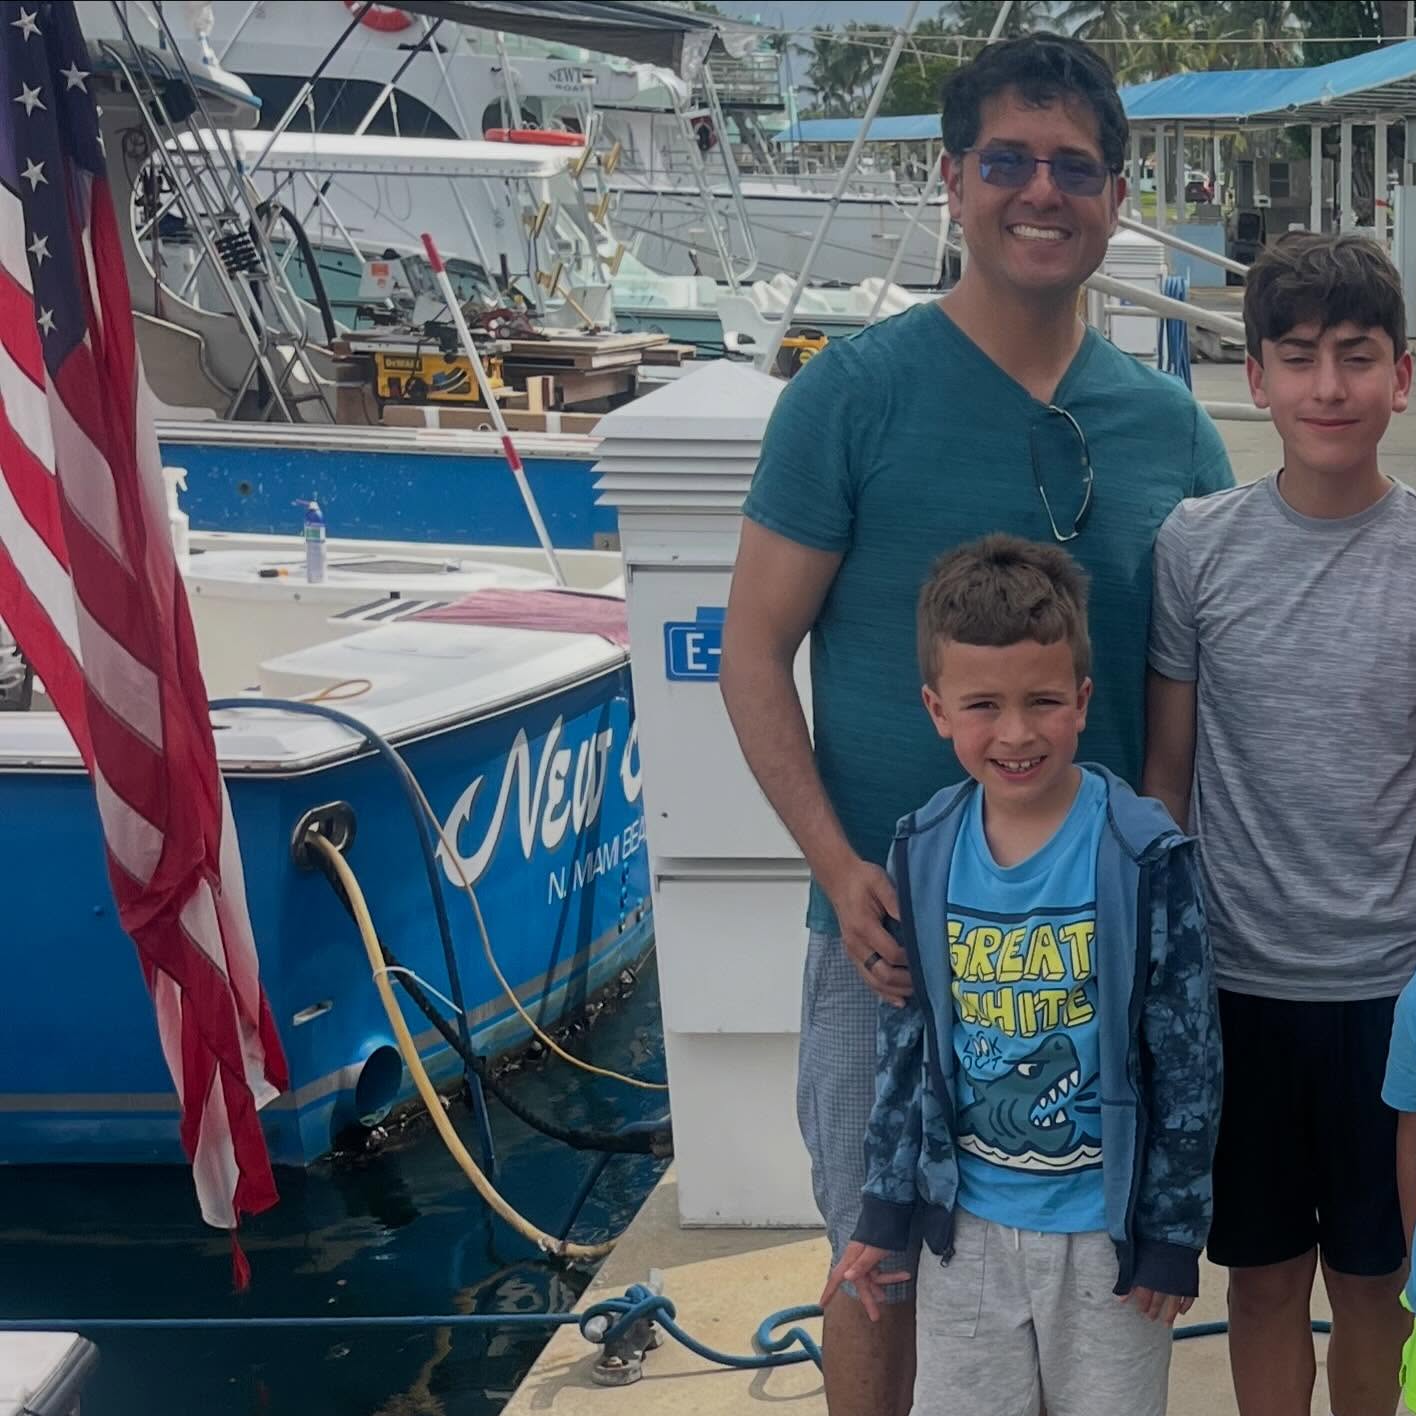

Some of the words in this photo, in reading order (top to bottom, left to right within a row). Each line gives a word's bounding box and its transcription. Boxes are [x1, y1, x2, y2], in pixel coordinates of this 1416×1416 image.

[685, 632, 722, 670] E-
[572, 835, 620, 892] MIAMI
[622, 815, 647, 861] BEA
[946, 920, 1096, 984] GREAT
[951, 980, 1097, 1039] WHITE
